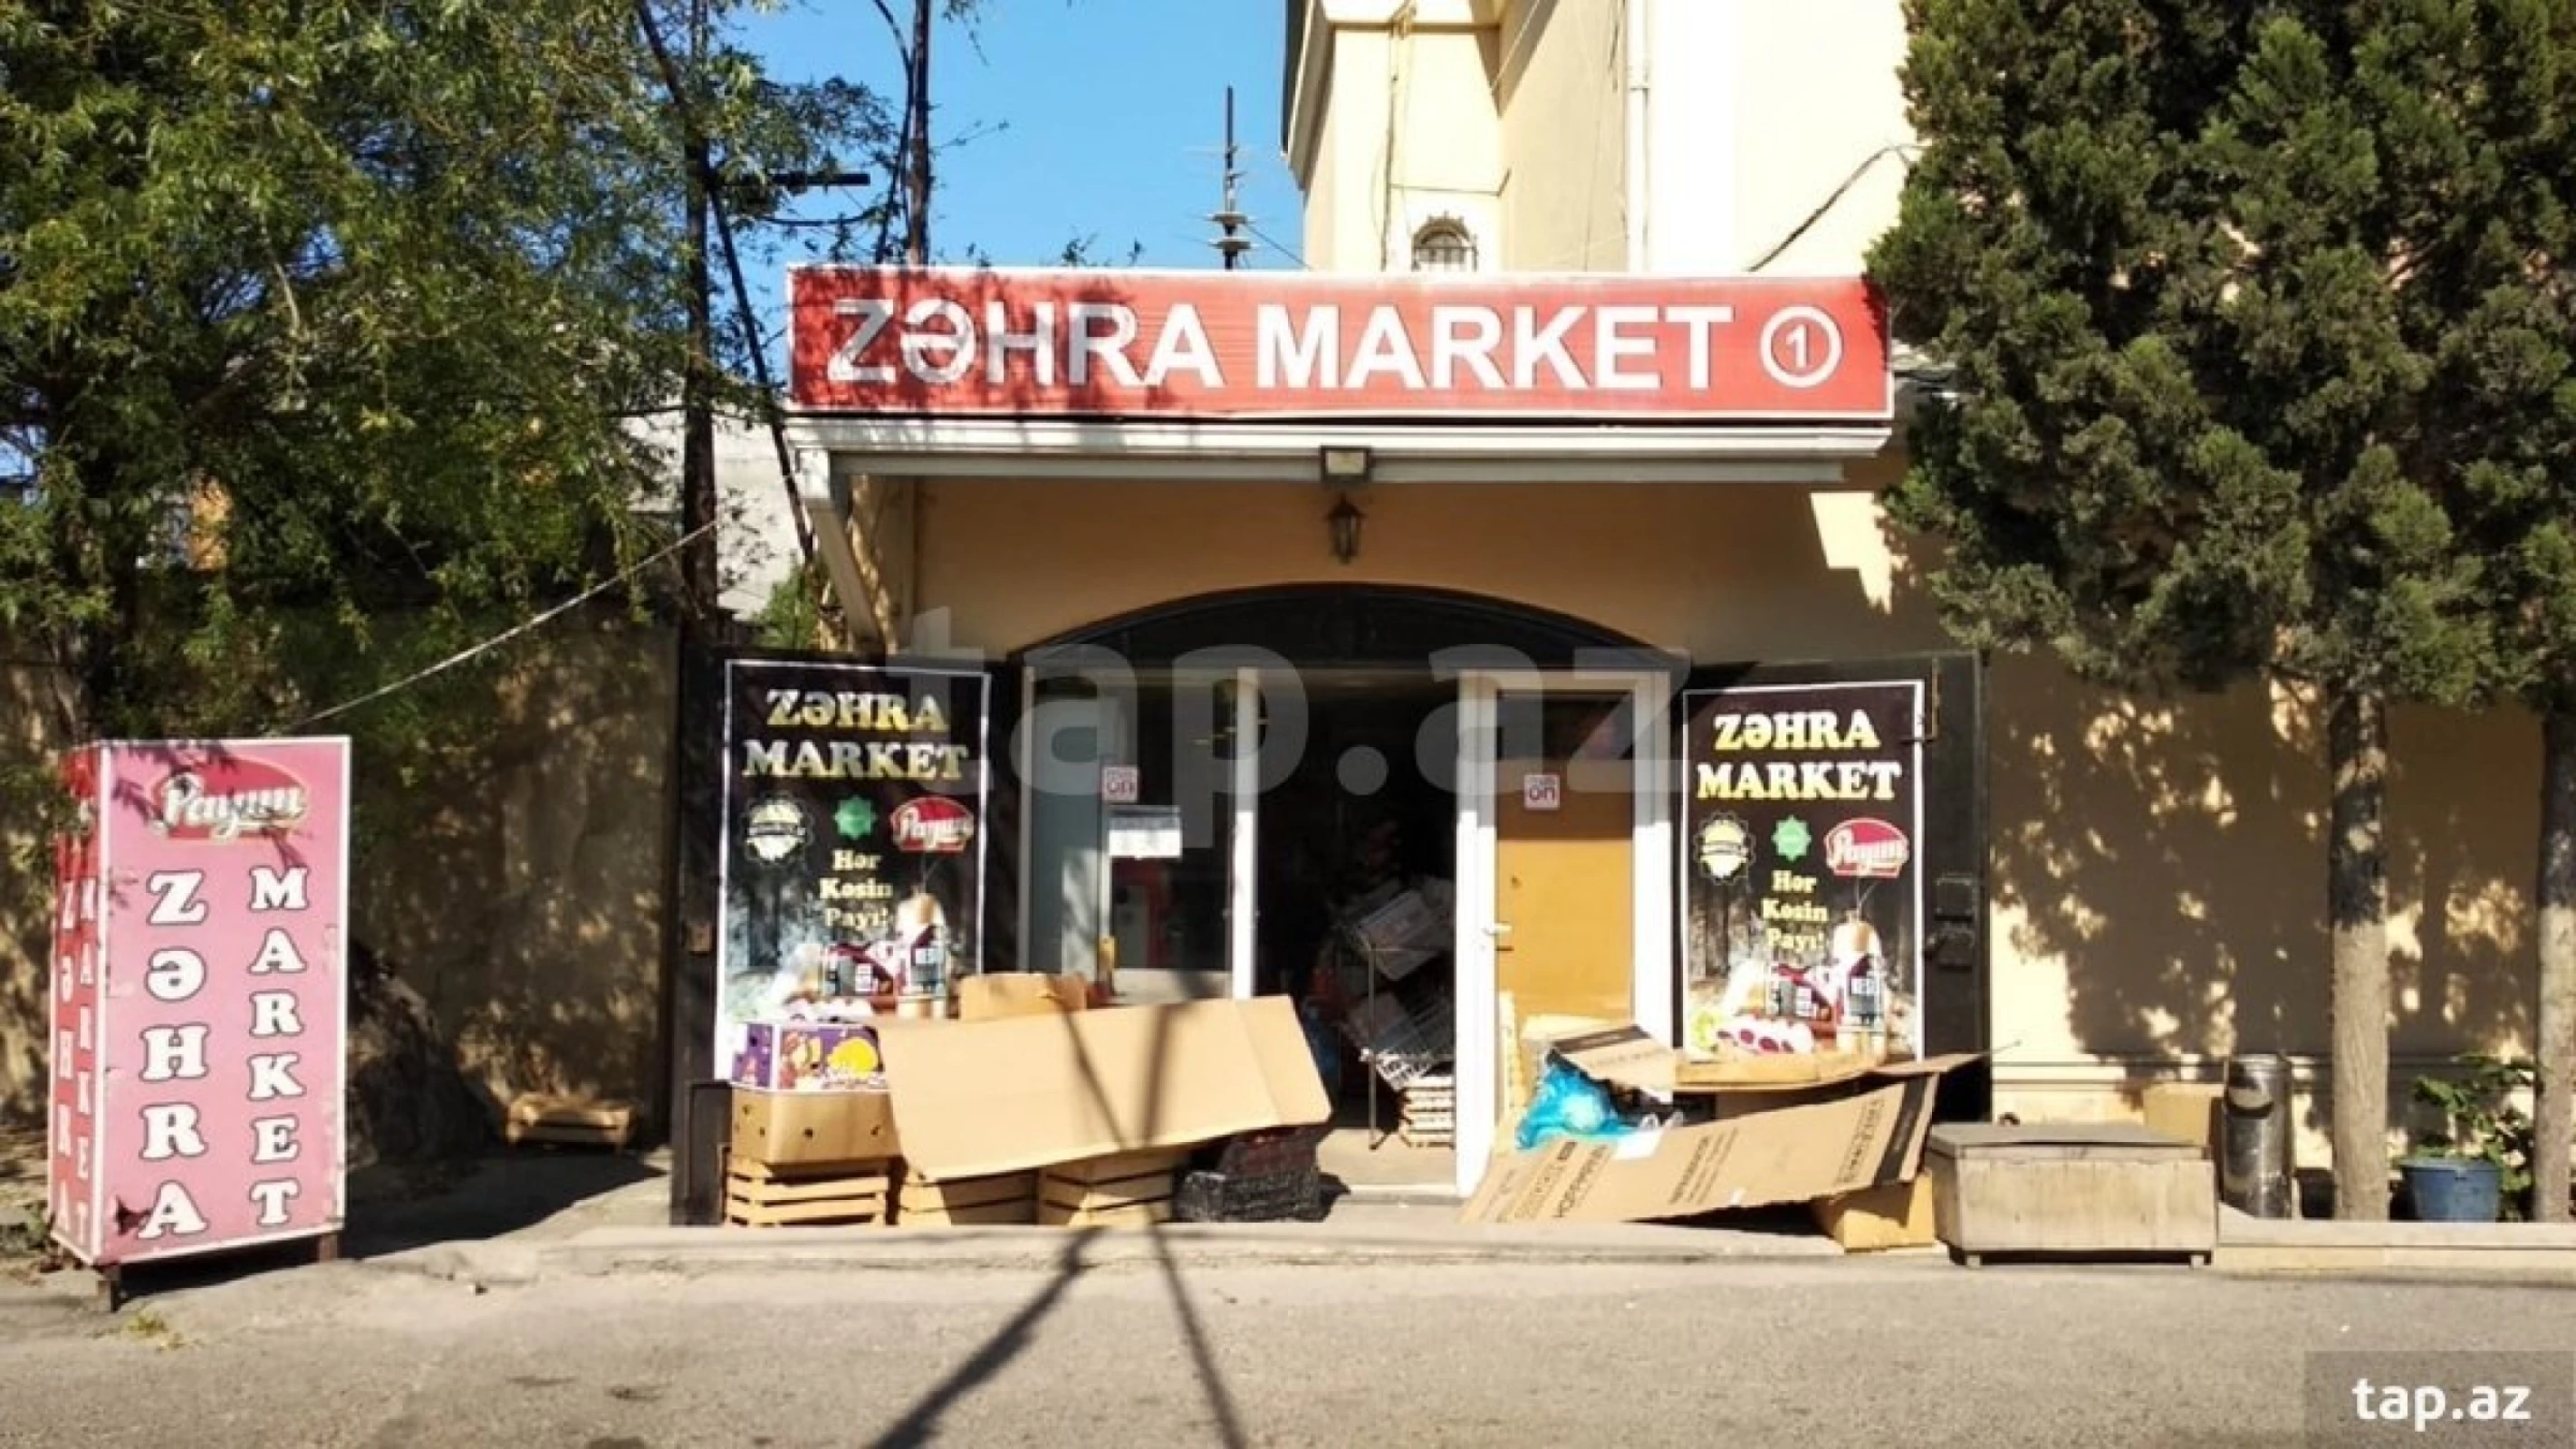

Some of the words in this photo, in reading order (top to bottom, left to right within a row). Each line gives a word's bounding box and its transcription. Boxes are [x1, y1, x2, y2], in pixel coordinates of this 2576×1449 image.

[826, 298, 1225, 388] ZƏHRA
[1255, 303, 1737, 390] MARKET
[766, 689, 948, 732] ZƏHRA
[1712, 709, 1881, 751] ZƏHRA
[742, 739, 969, 780] MARKET
[1697, 761, 1903, 800] MARKET
[138, 869, 210, 1241] ZƏHRA
[247, 865, 310, 1228] MARKET
